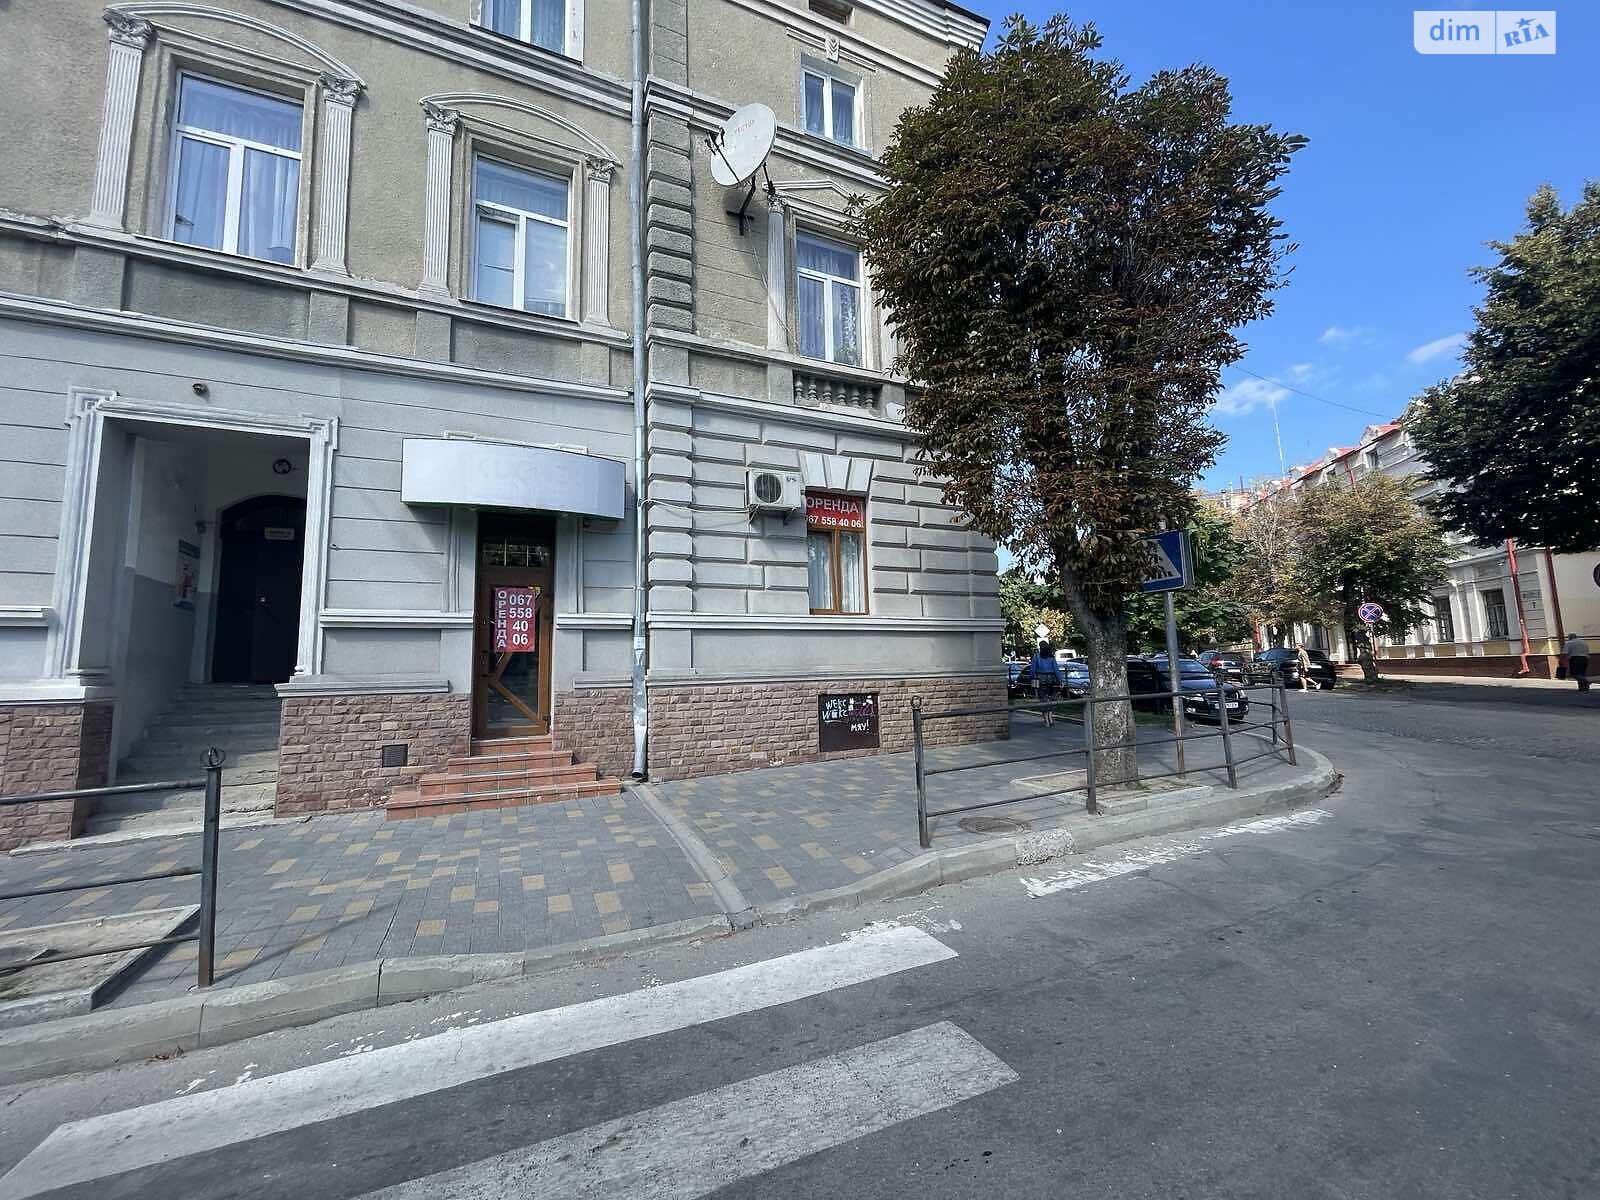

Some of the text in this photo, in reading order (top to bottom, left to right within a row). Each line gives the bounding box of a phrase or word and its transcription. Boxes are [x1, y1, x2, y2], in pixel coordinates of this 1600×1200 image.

[806, 497, 859, 514] ОРЕНДА
[821, 516, 837, 526] 558
[838, 518, 849, 527] 40
[509, 594, 532, 606] 067
[509, 607, 532, 619] 558
[497, 591, 507, 648] ОРЕНДА
[512, 620, 528, 632] 40
[512, 633, 528, 645] 06
